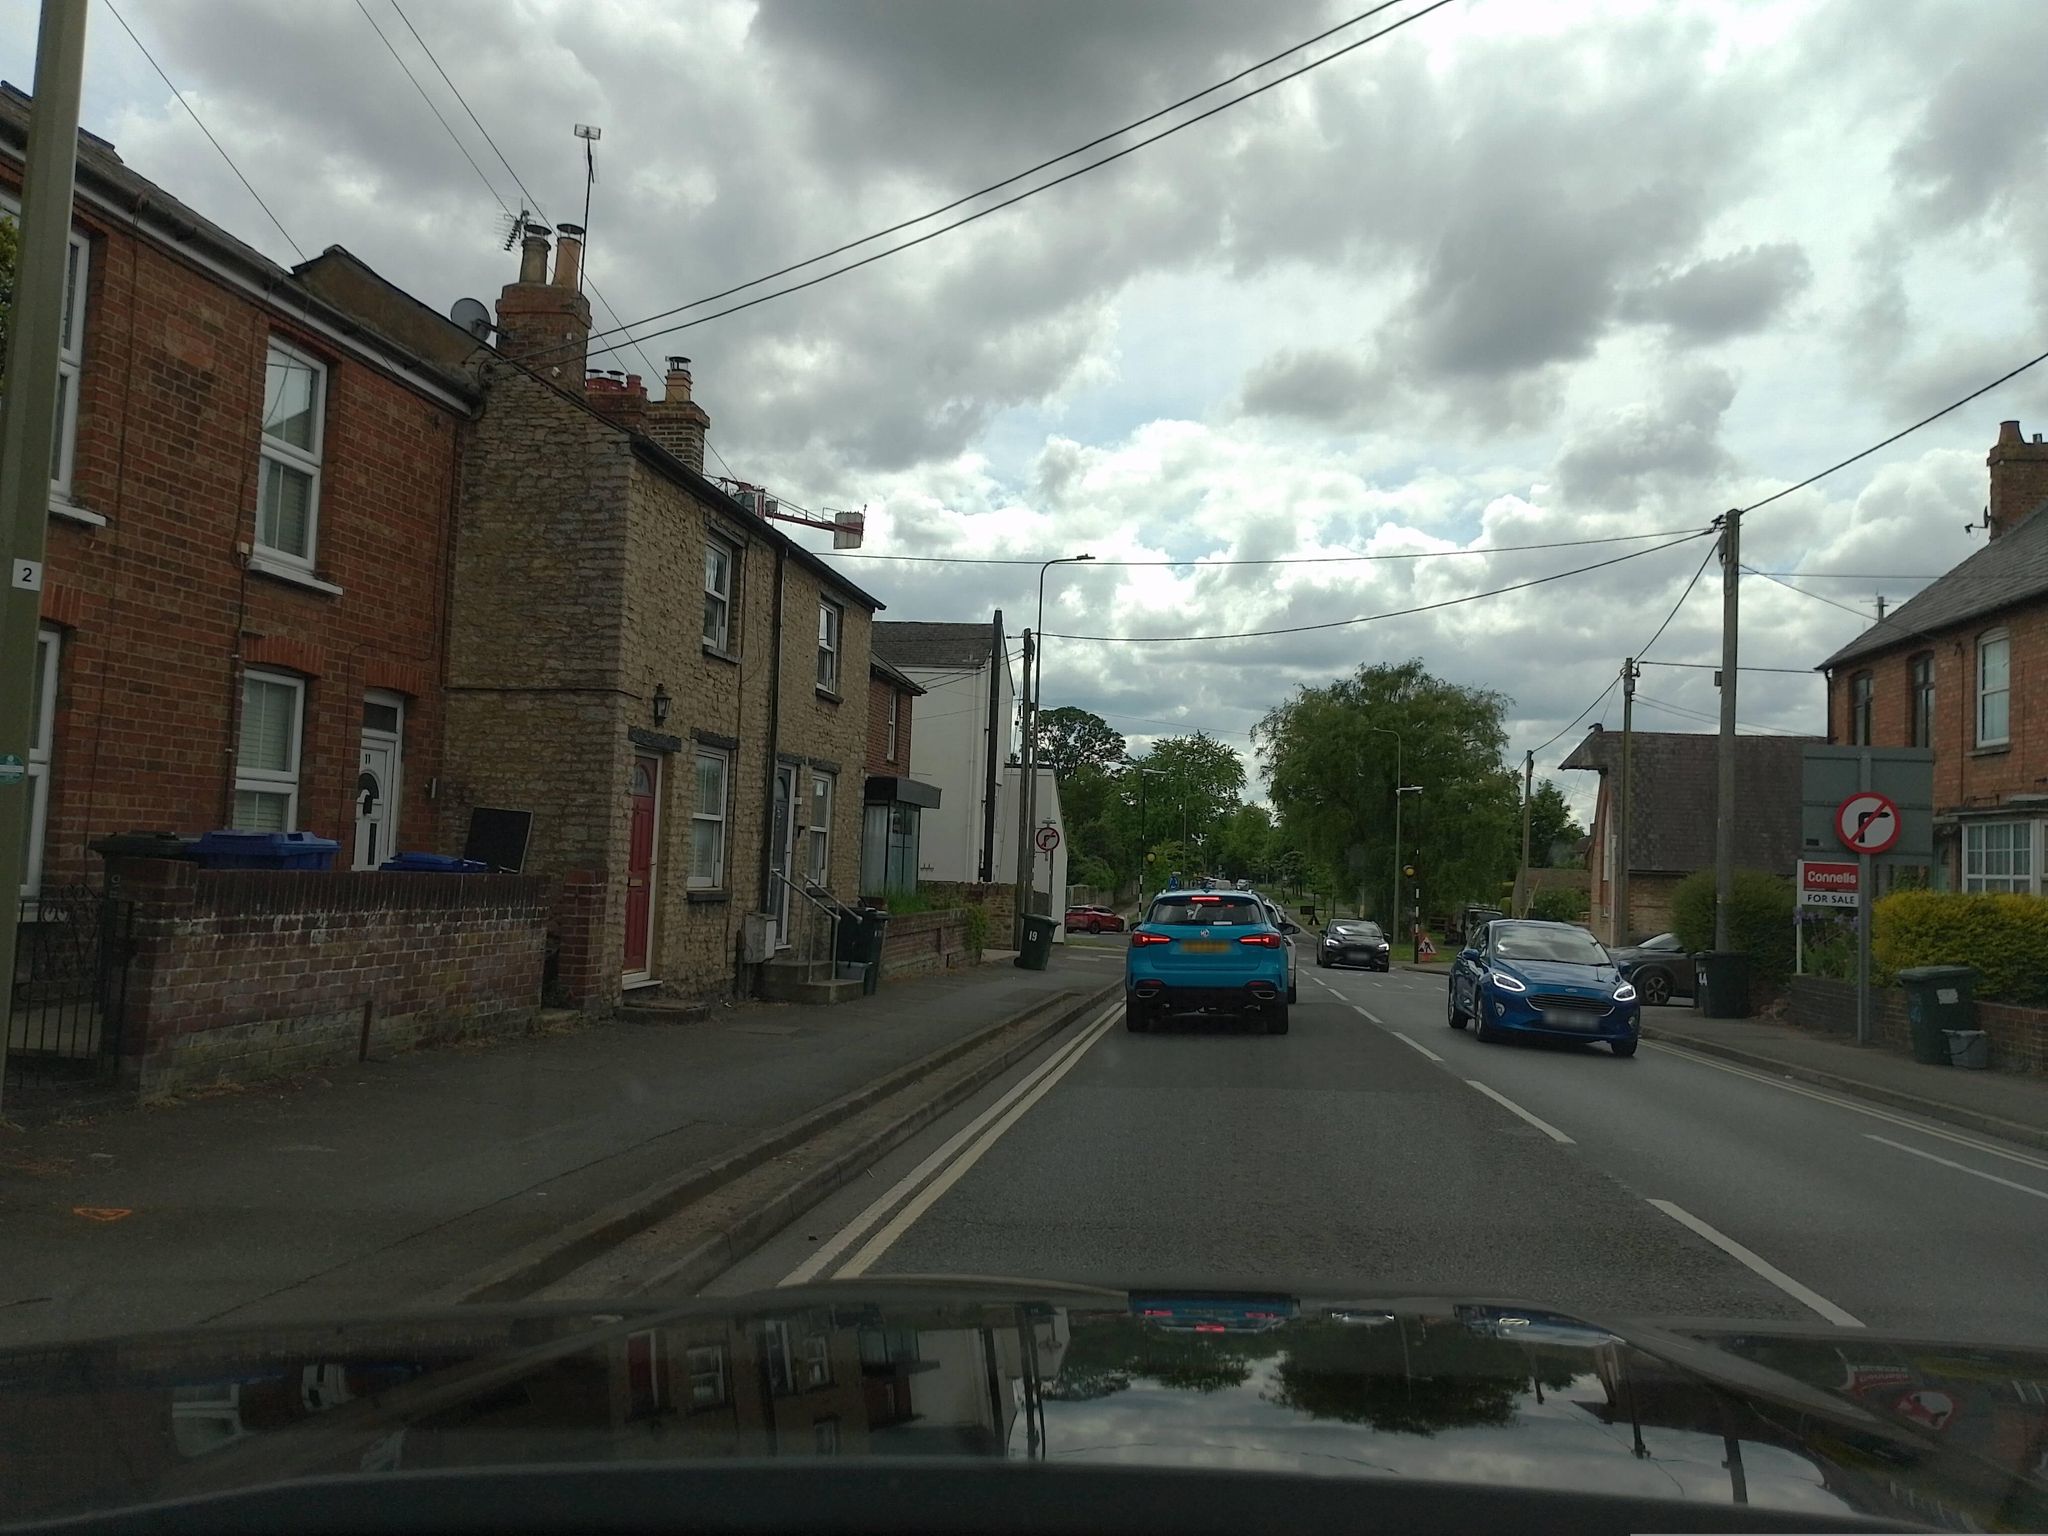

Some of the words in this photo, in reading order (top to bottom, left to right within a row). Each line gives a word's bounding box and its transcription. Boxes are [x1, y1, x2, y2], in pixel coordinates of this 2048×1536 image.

[22, 567, 33, 582] 2
[1807, 870, 1857, 884] Connells
[1807, 894, 1828, 903] FOR
[1831, 895, 1855, 905] SALE
[1028, 930, 1038, 942] 19
